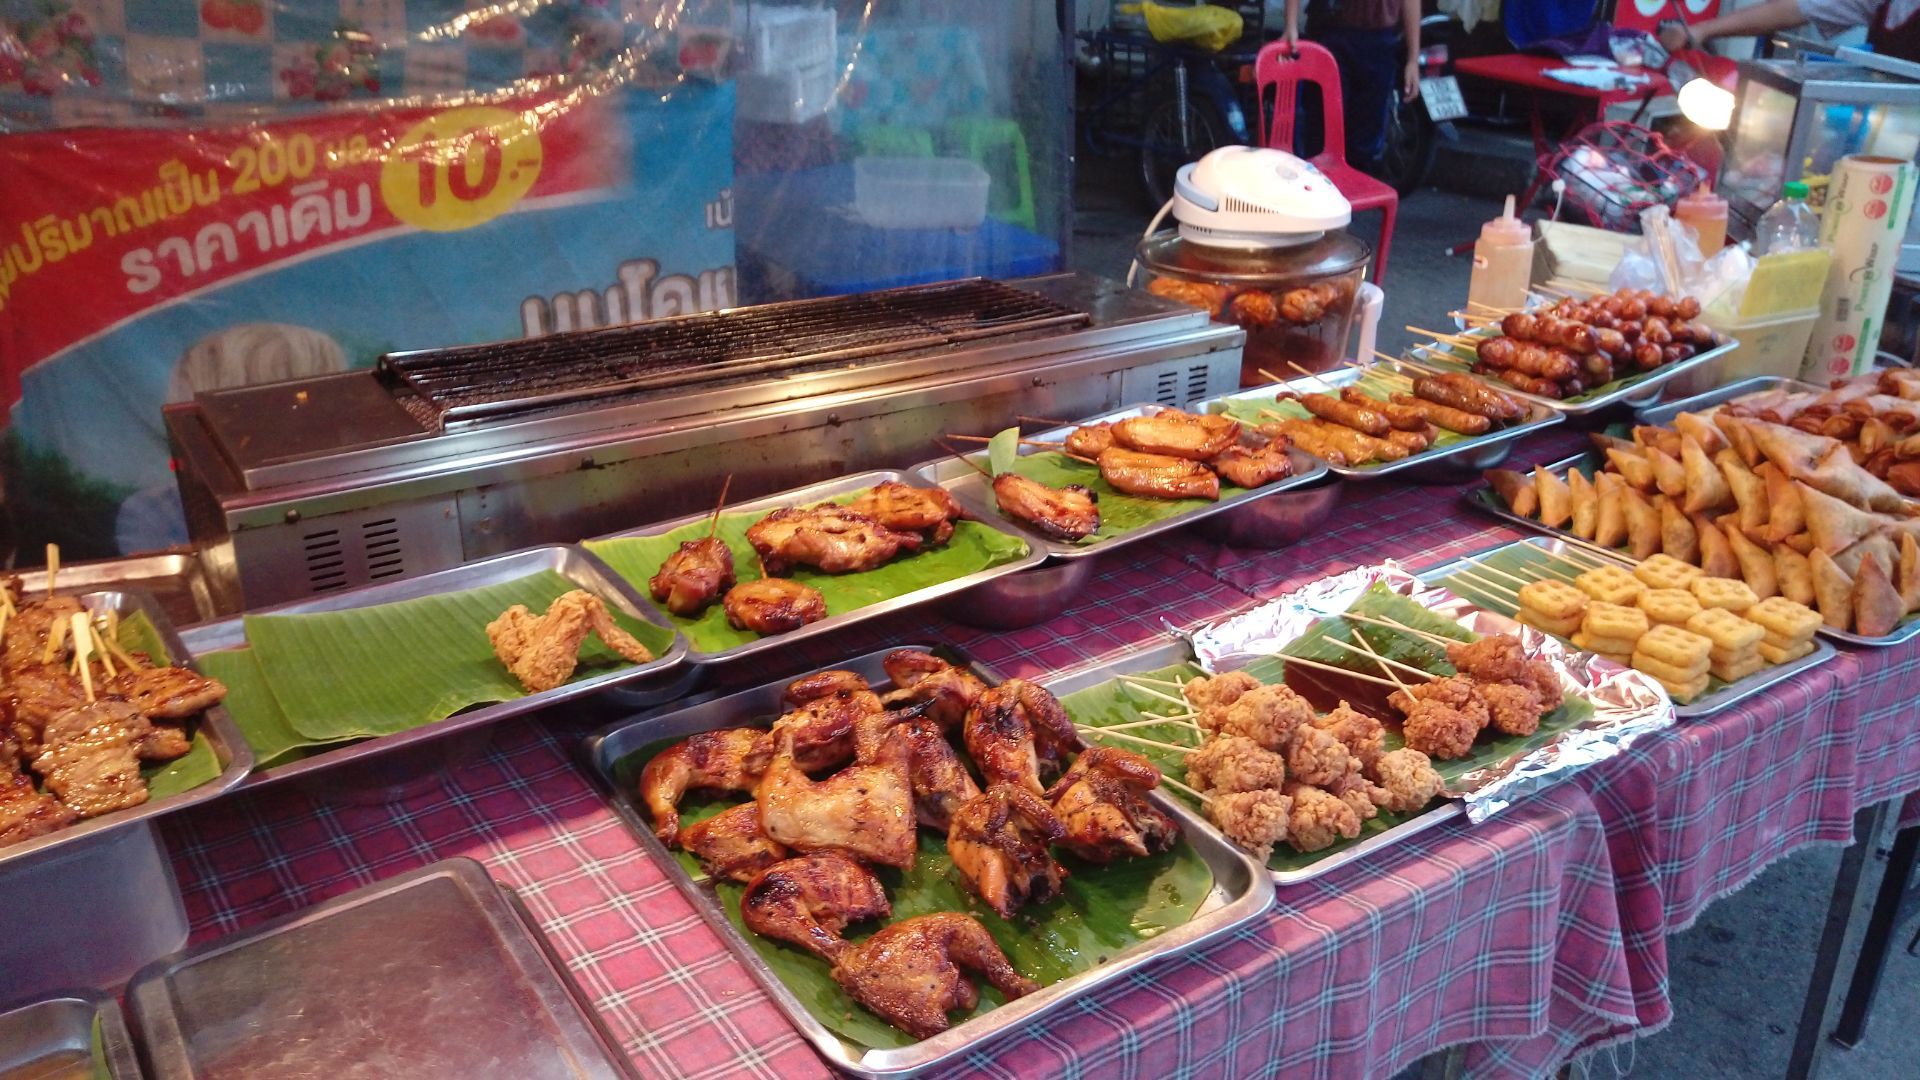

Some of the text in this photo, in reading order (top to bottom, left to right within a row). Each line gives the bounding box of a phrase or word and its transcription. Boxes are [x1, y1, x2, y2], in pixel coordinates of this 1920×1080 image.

[231, 132, 316, 194] 200
[121, 179, 372, 293] ราคาเดิม
